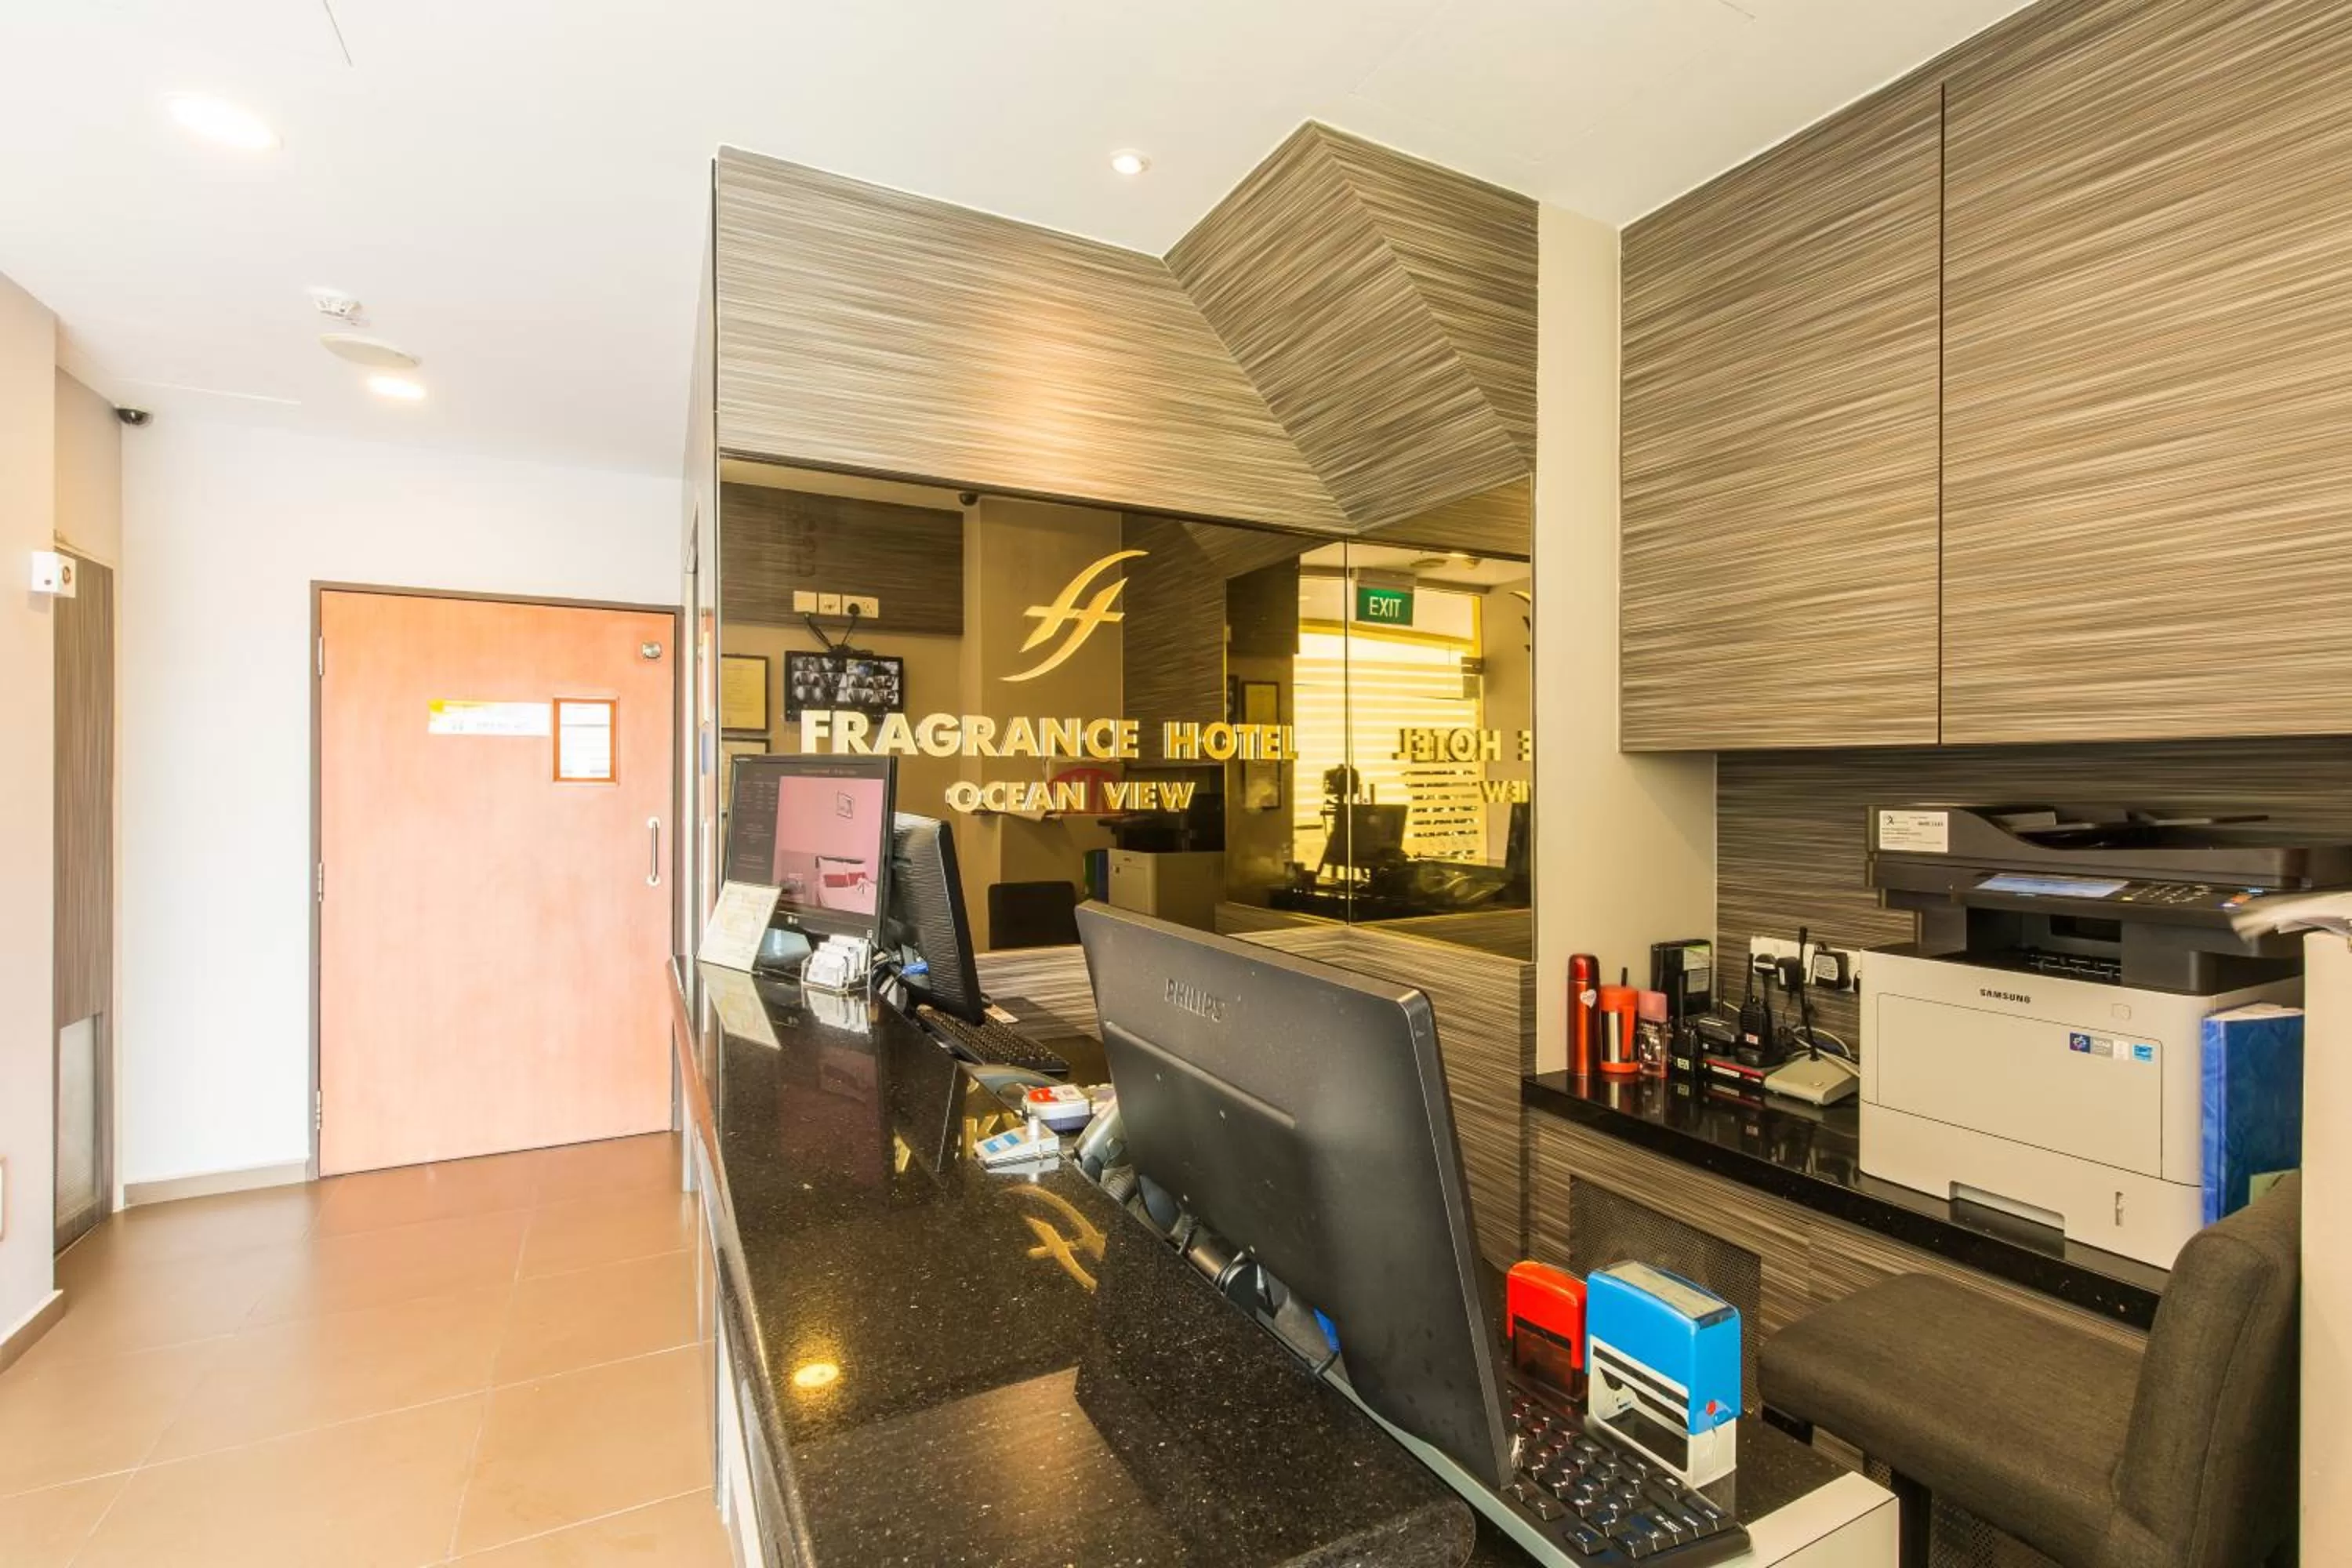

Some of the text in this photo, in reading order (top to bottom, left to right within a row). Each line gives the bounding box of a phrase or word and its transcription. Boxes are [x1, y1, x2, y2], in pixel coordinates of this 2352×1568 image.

[1369, 596, 1402, 618] EXIT
[800, 710, 1299, 760] FRAGRANCE HOTEL
[946, 780, 1196, 813] OCEAN VIEW
[1164, 978, 1222, 1023] PHILIPS
[1980, 989, 2031, 1004] SAMSUNG
